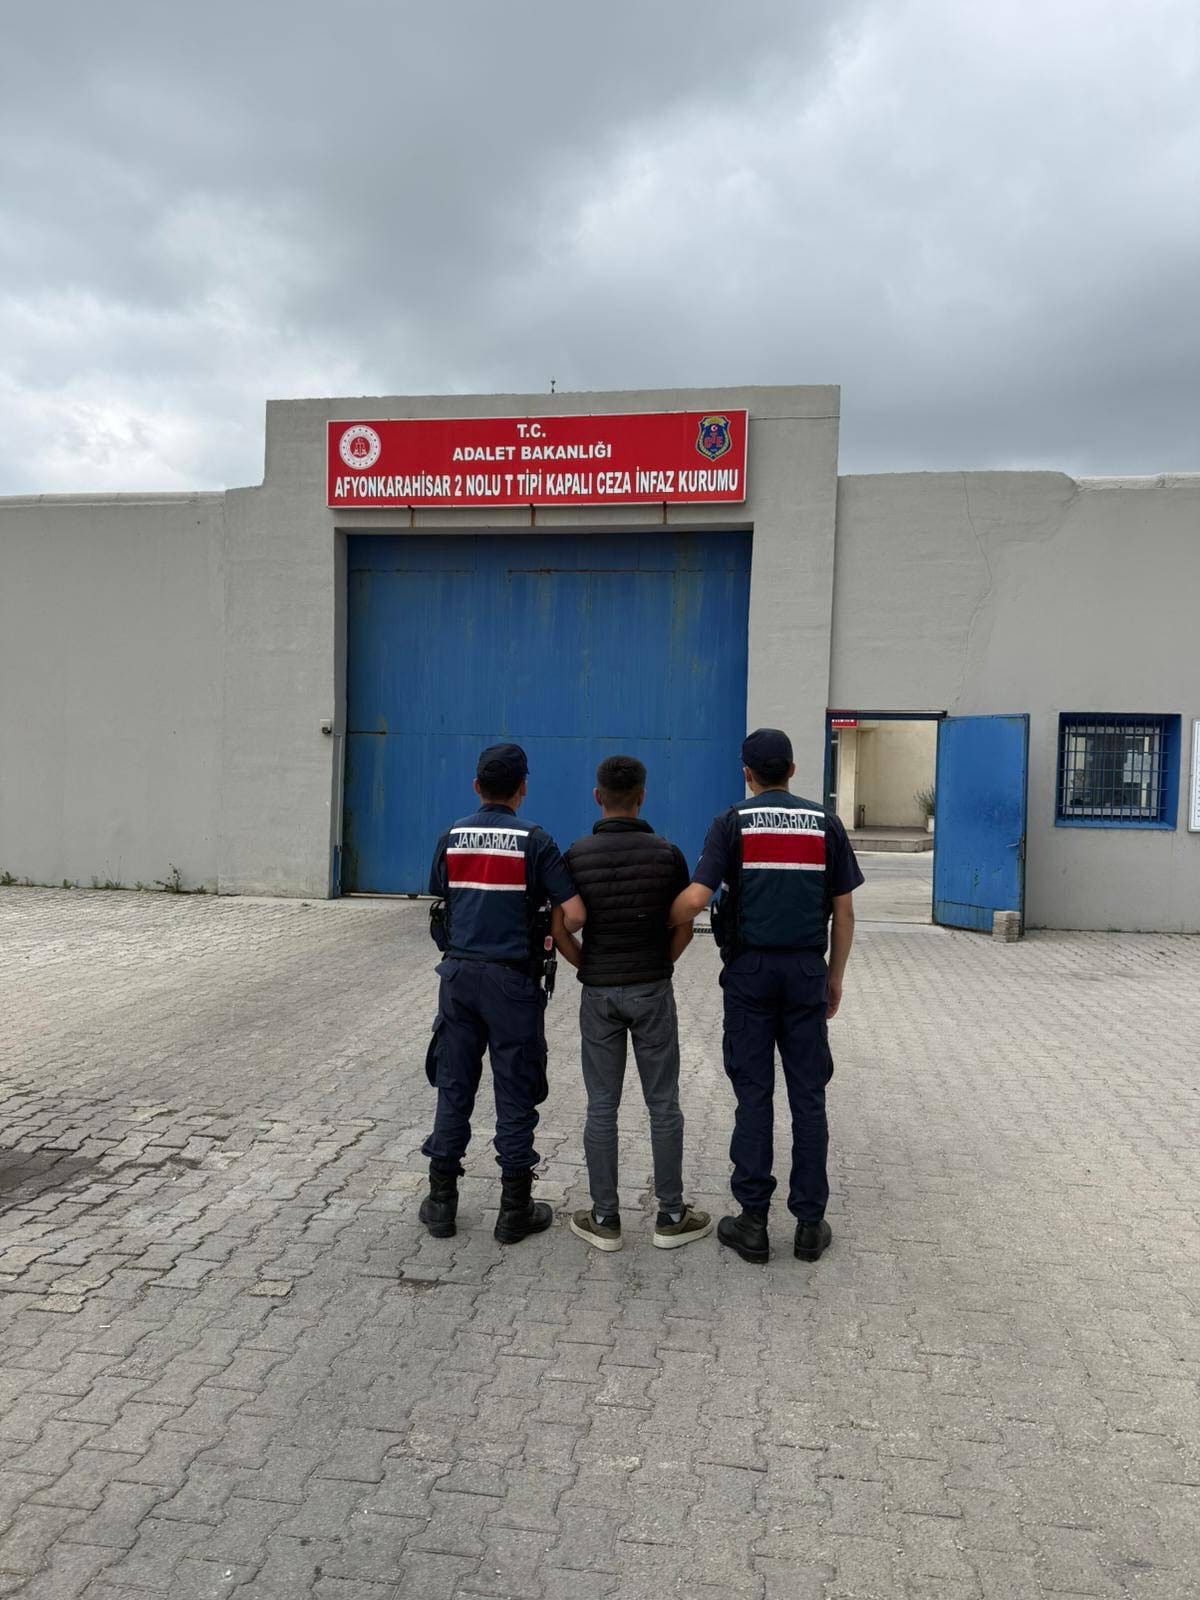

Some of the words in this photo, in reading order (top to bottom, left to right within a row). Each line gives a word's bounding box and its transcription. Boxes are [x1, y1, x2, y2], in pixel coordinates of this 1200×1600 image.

[517, 423, 547, 438] T.C.
[452, 446, 516, 461] ADALET
[520, 441, 612, 460] BAKANLIĞI
[334, 470, 451, 498] AFYONKARAHİSAR
[454, 477, 463, 497] 2
[466, 474, 501, 497] NOLU
[505, 474, 514, 496] T
[517, 468, 542, 496] TİPİ
[546, 472, 593, 496] KAPALI
[596, 471, 632, 494] CEZA
[635, 466, 675, 493] İNFAZ
[678, 469, 739, 493] KURUMU
[749, 811, 819, 830] JANDARMA
[454, 832, 519, 851] JANDARMA
